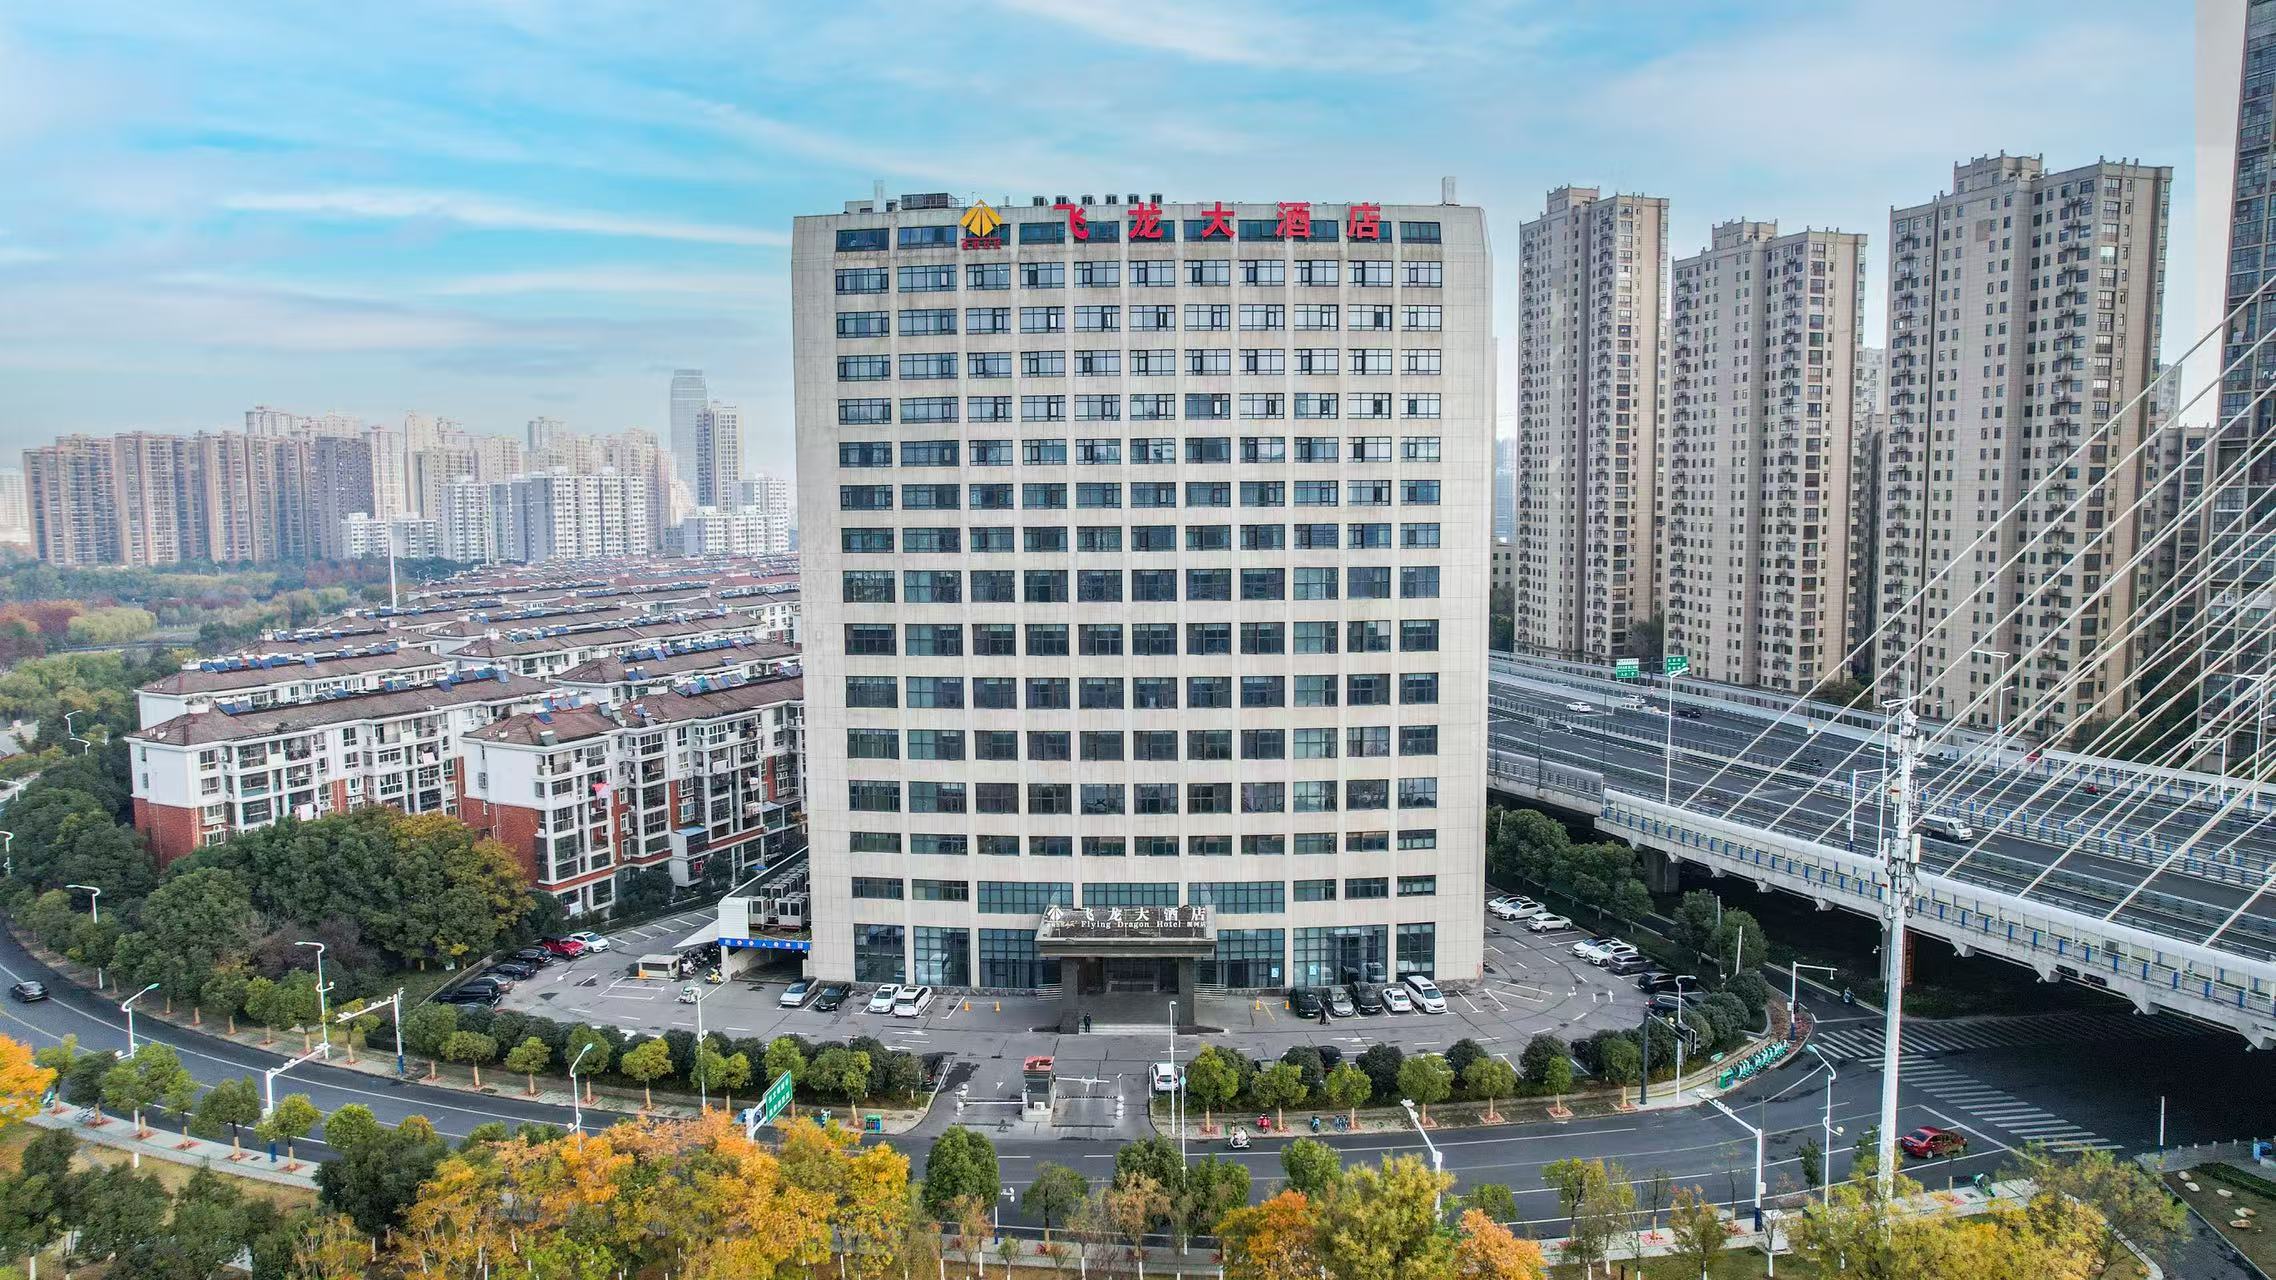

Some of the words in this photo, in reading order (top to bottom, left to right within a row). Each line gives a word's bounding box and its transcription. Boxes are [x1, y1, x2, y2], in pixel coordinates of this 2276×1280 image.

[1053, 201, 1381, 239] 飞龙大酒店
[1081, 906, 1206, 921] 飞龙大酒店
[1081, 921, 1111, 929] Flying
[1117, 921, 1150, 929] Dragon
[1157, 920, 1181, 928] Hotel
